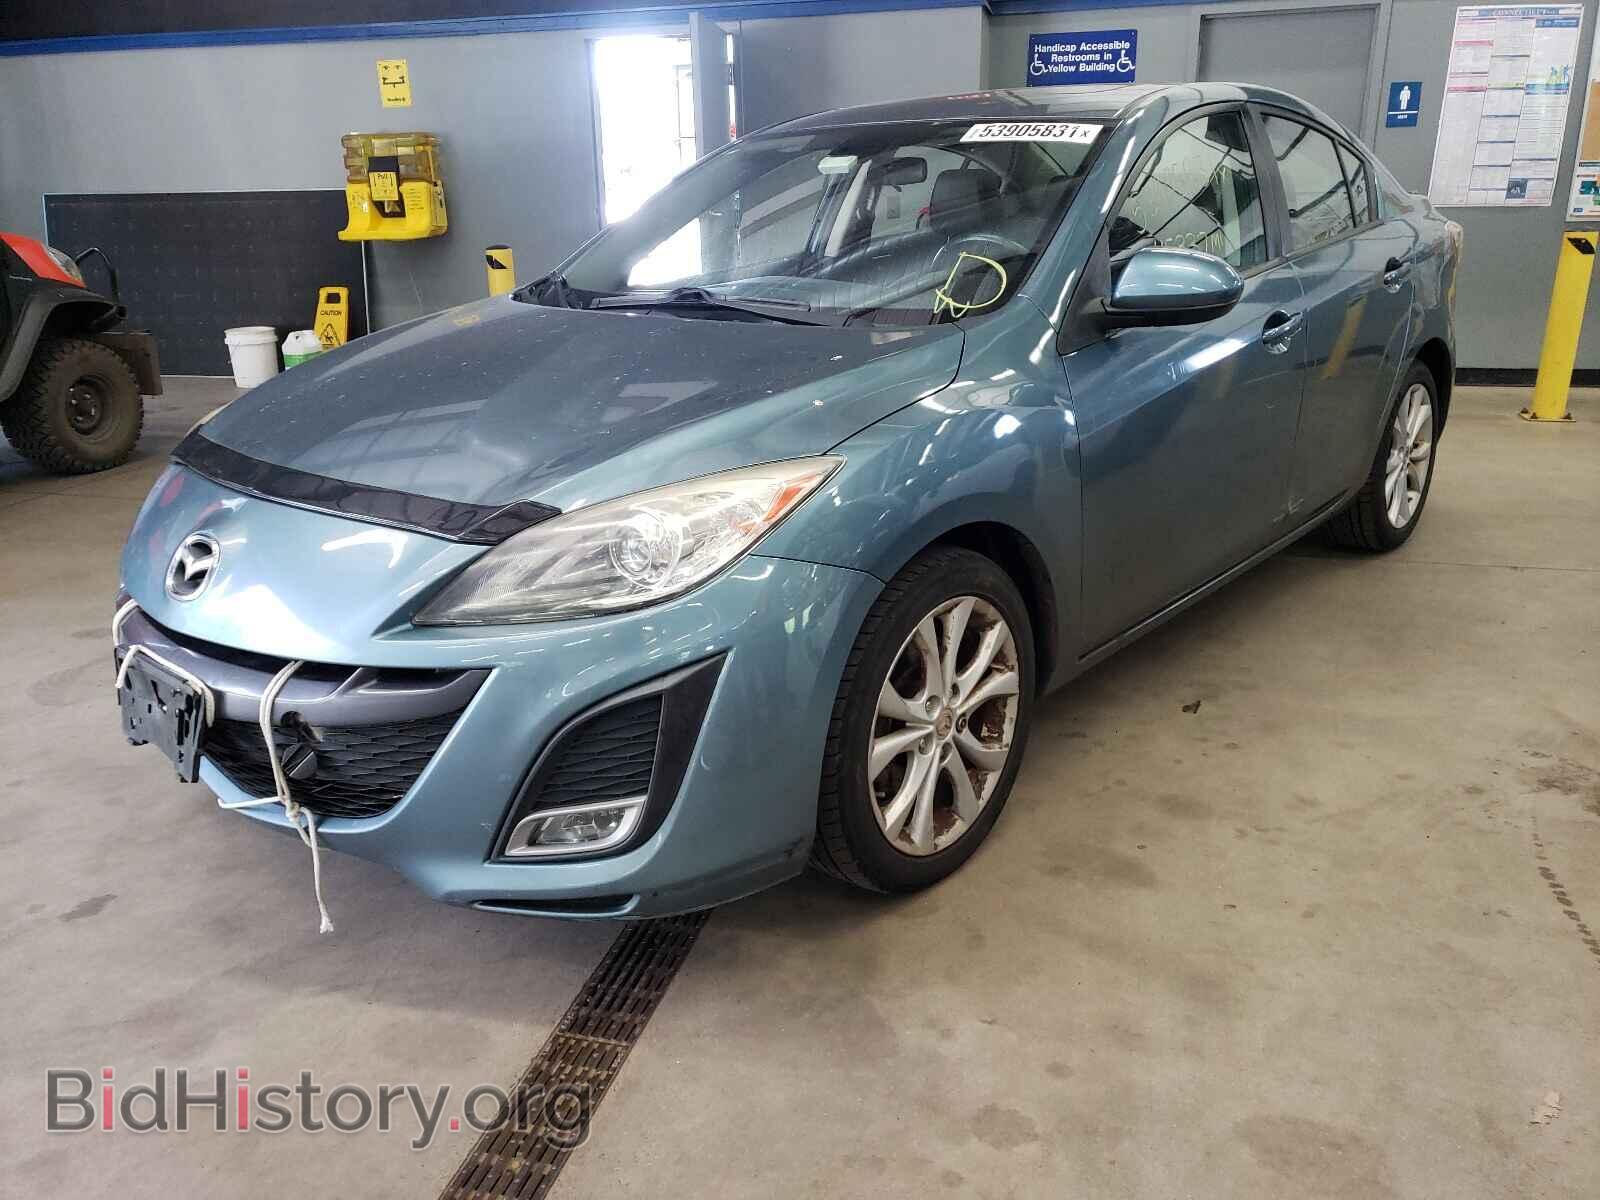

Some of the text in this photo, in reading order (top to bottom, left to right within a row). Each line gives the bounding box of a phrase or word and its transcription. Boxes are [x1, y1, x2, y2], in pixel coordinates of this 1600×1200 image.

[1035, 40, 1131, 53] Handicap Accessible
[1051, 52, 1101, 63] Restrooms
[1048, 61, 1116, 73] Yellow Building
[979, 124, 1081, 138] 53905831
